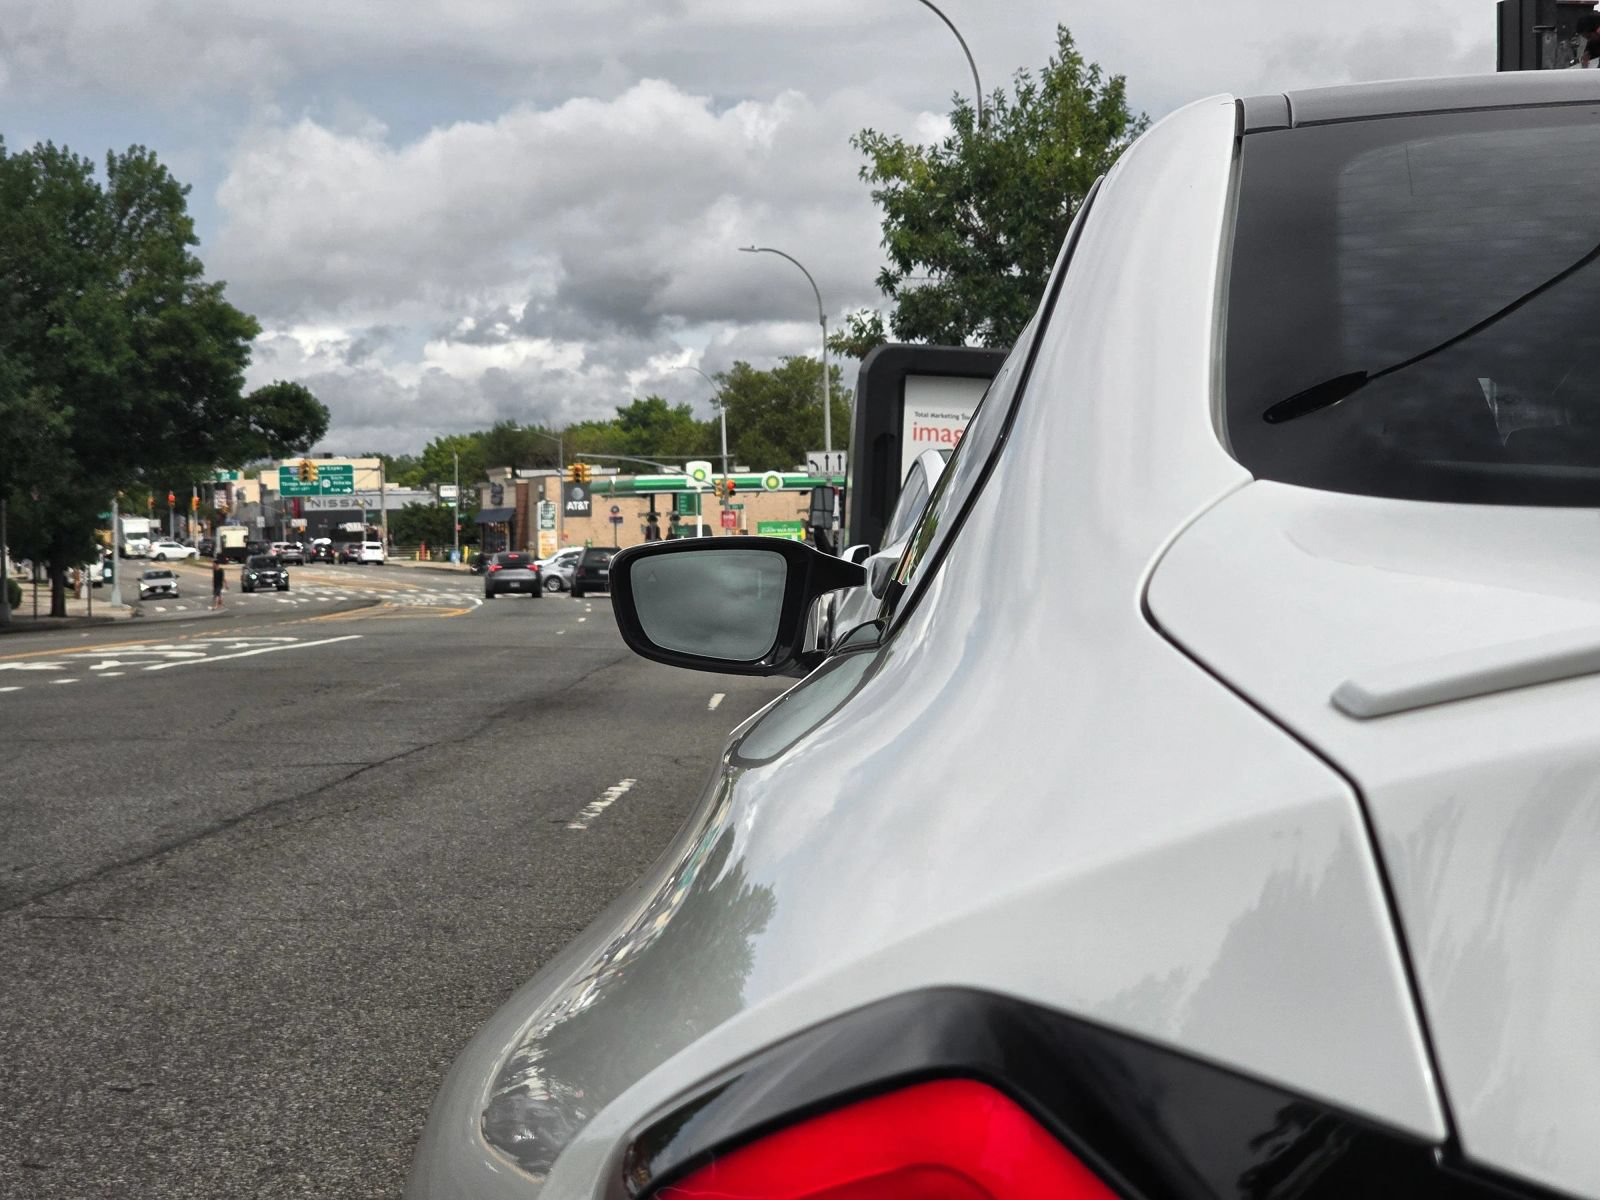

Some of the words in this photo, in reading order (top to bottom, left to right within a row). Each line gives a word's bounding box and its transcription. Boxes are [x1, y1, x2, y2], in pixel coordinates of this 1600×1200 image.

[930, 412, 960, 421] Marketing
[311, 499, 373, 508] NISSAN
[566, 501, 590, 511] AT&T
